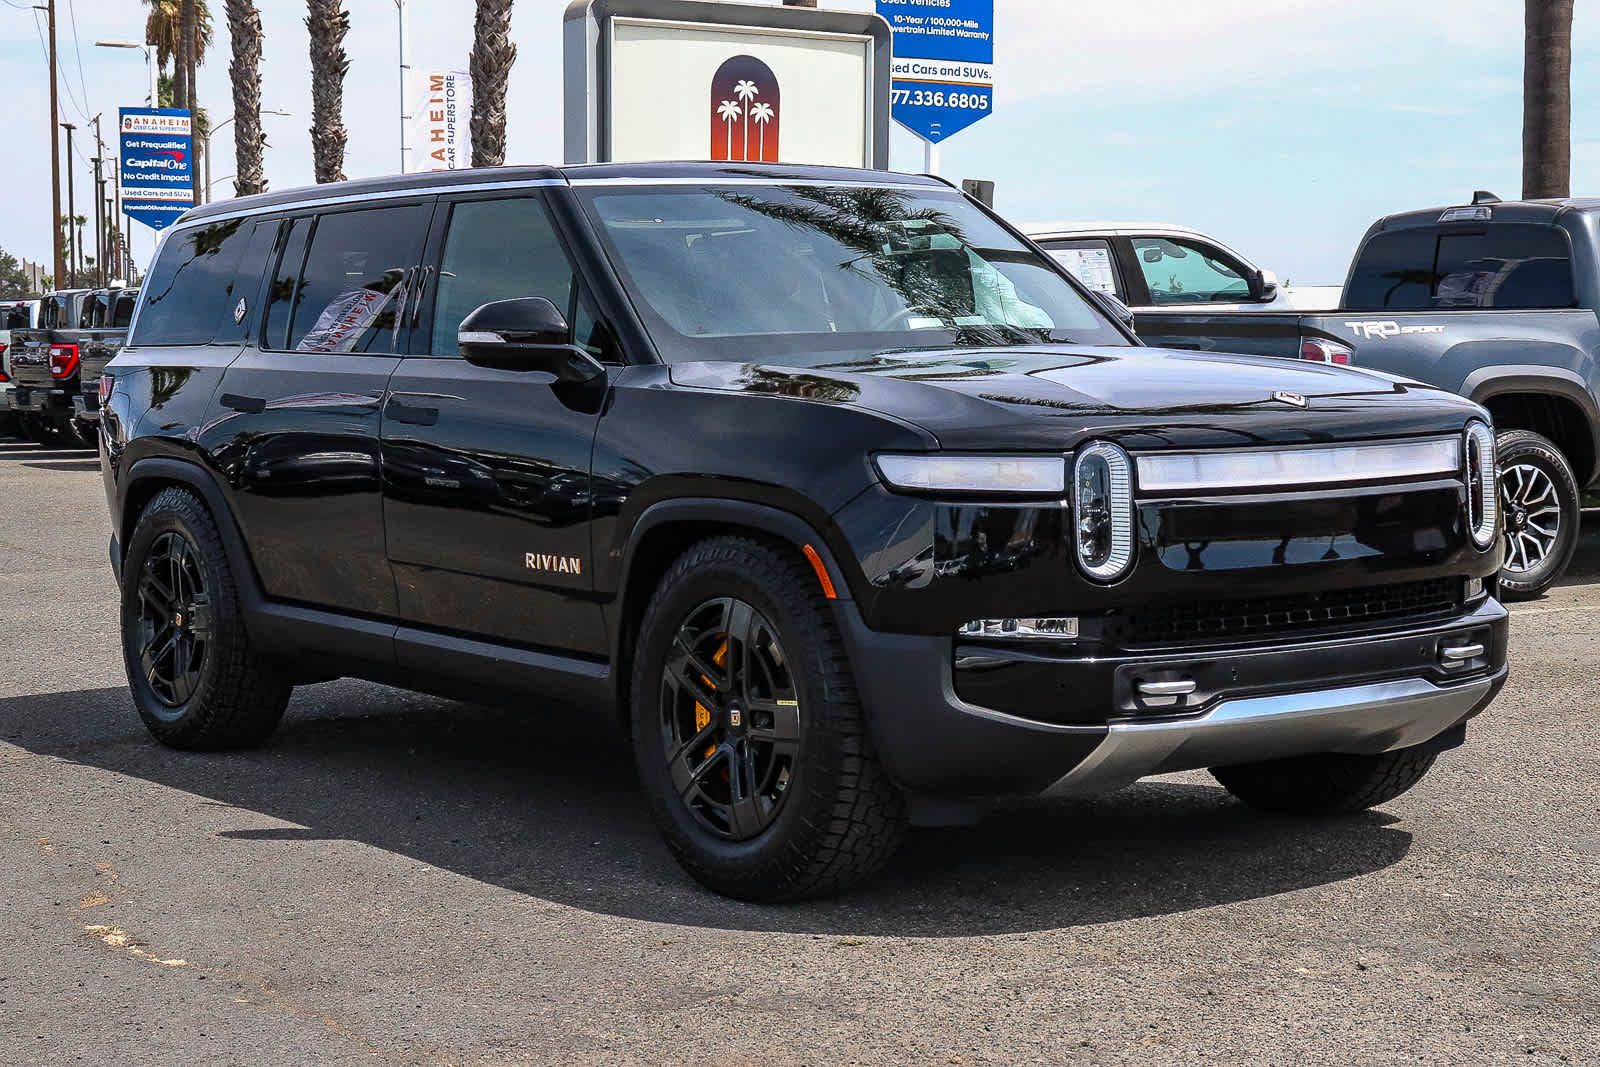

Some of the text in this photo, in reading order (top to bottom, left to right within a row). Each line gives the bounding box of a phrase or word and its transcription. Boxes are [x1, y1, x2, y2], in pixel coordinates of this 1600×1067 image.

[893, 15, 924, 24] 10-Year
[930, 17, 979, 29] 100,000-Mile
[891, 25, 989, 40] wertrain Limited Warranty
[912, 64, 938, 75] Cars
[940, 67, 961, 77] and
[963, 67, 992, 79] SUVs.
[891, 89, 988, 110] 77.336.6805
[134, 117, 189, 127] ANAHEIM
[430, 75, 446, 173] AHEIM
[446, 75, 456, 170] CAR SUPERSTORE
[141, 141, 186, 150] Prequalified
[123, 172, 136, 180] No
[136, 172, 160, 180] Credit
[1344, 320, 1447, 340] TRD SPORT
[525, 552, 581, 574] RIVIAN
